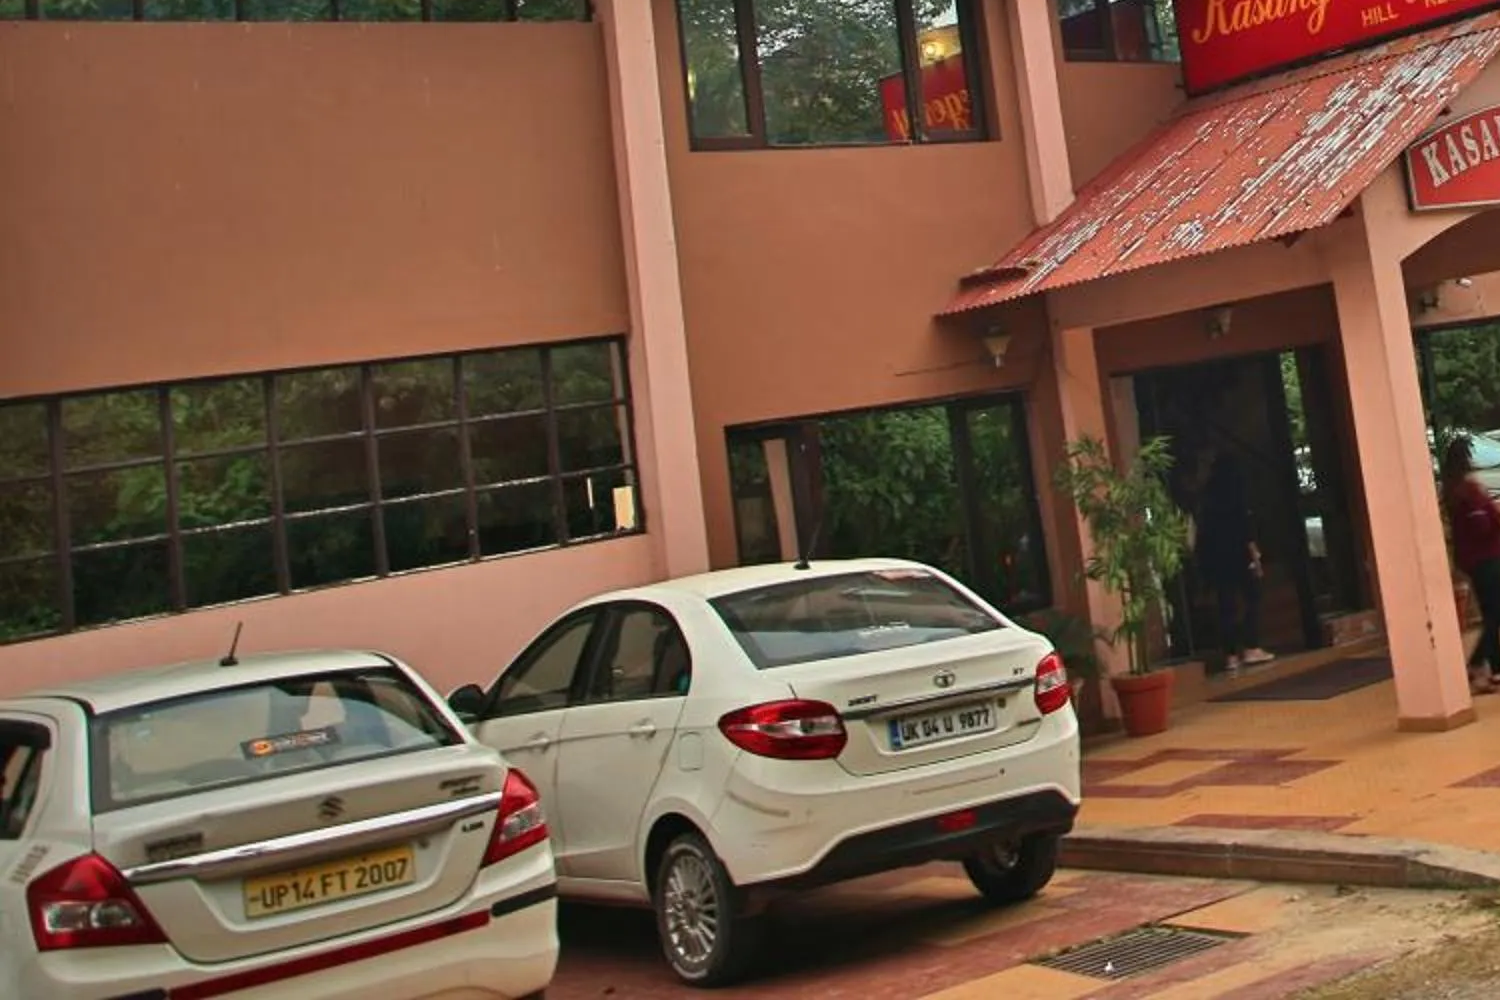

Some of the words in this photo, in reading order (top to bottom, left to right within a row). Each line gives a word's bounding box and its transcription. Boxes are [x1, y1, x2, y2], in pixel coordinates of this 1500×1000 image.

[1361, 4, 1399, 28] HILL
[320, 869, 350, 897] FT
[354, 858, 408, 890] 2007
